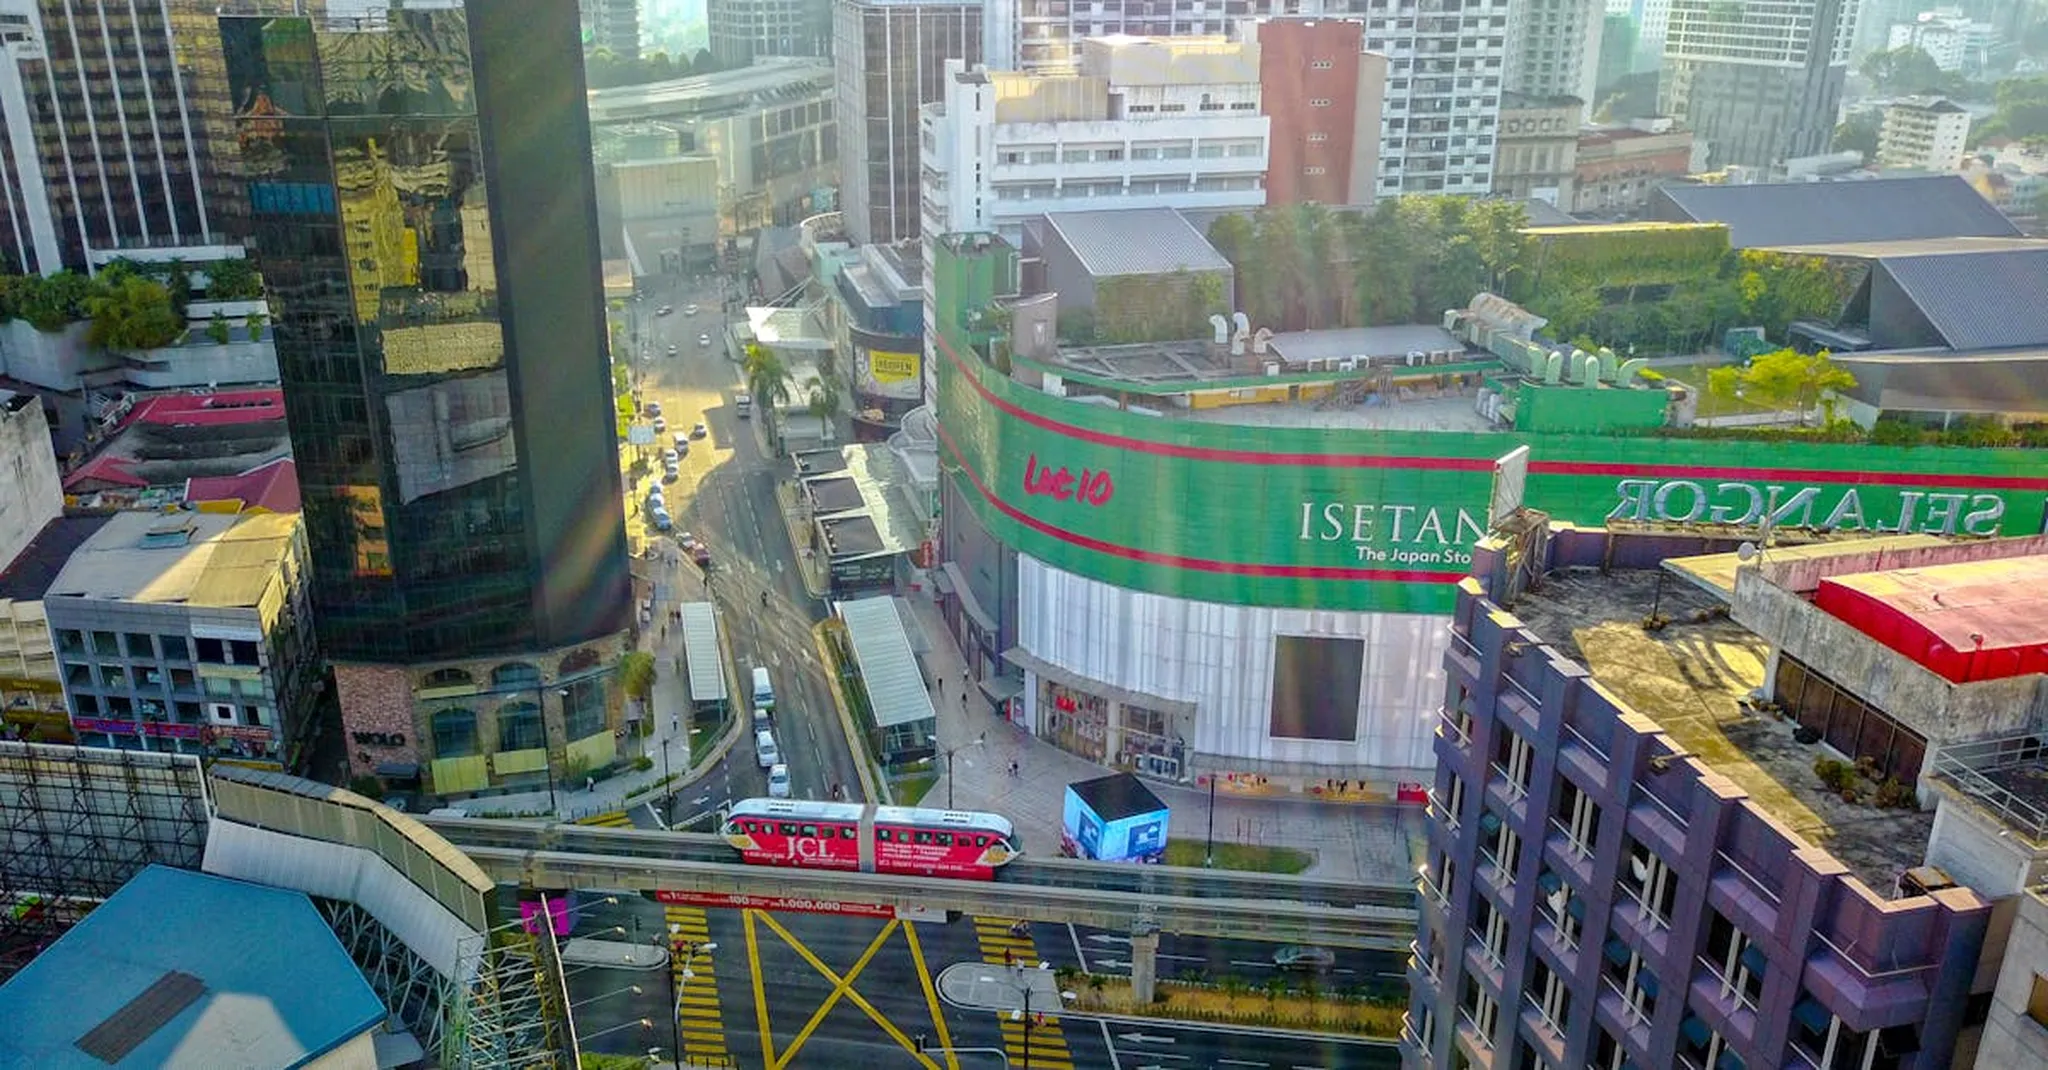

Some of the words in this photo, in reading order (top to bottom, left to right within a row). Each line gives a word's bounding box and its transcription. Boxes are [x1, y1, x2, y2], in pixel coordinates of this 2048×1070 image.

[1024, 452, 1076, 501] Lot
[1076, 467, 1114, 507] 10
[1298, 502, 1489, 545] ISETAN
[1356, 546, 1387, 561] The
[1389, 550, 1440, 564] Japan
[1443, 550, 1471, 564] Sto
[352, 731, 406, 746] WOLO
[786, 836, 835, 859] JCL
